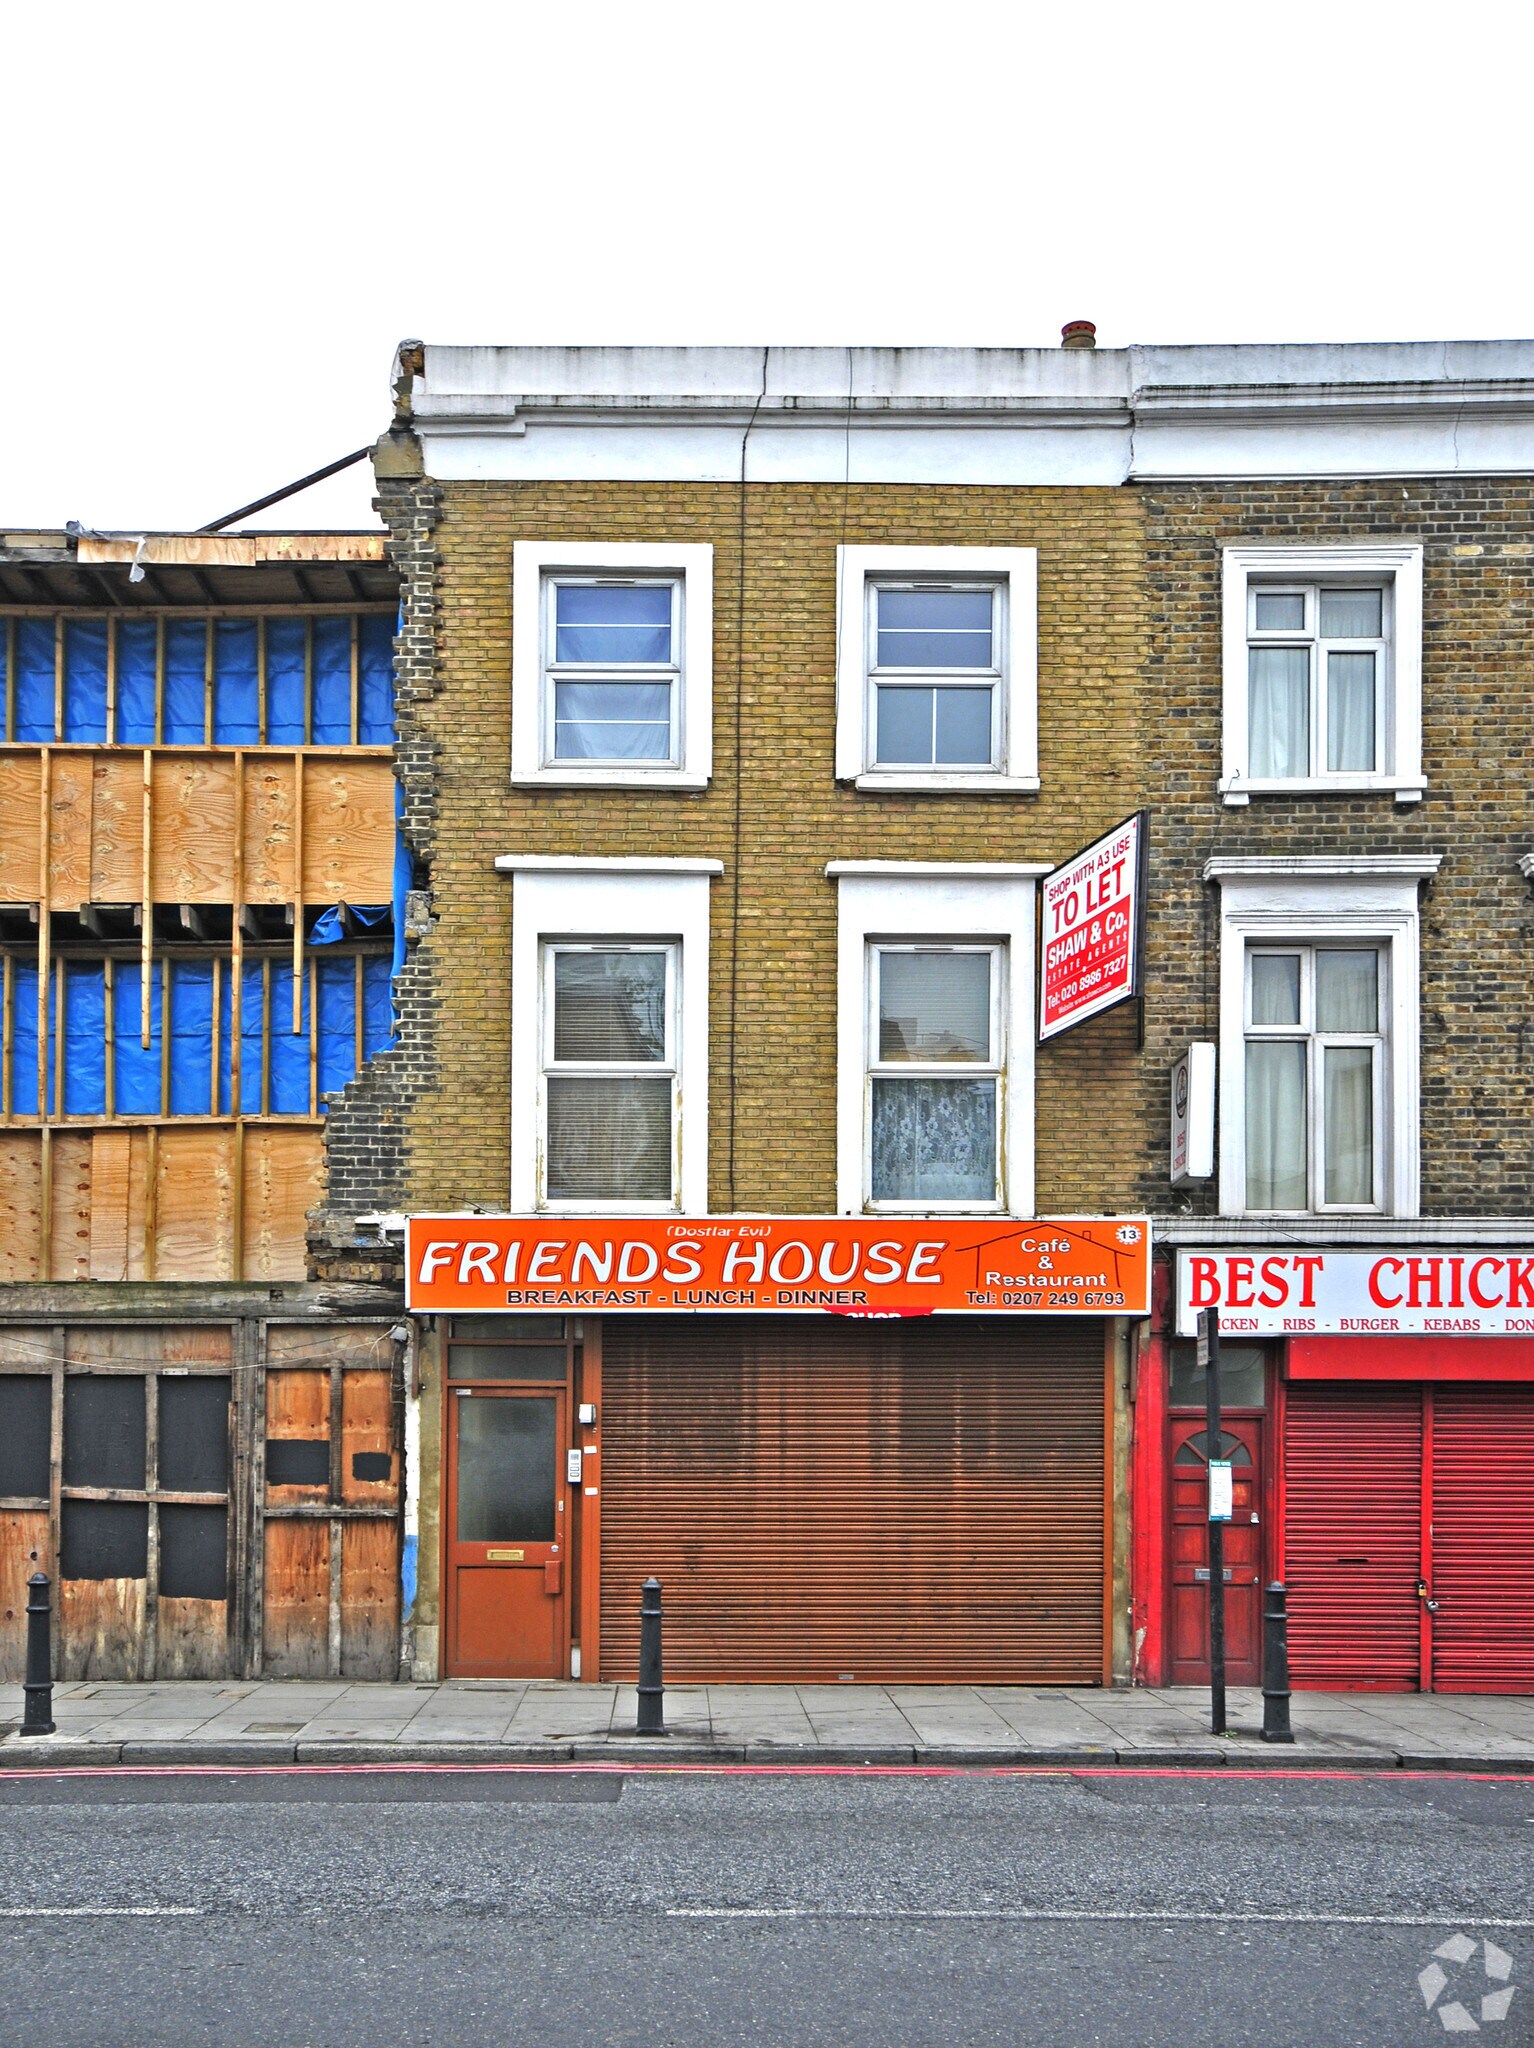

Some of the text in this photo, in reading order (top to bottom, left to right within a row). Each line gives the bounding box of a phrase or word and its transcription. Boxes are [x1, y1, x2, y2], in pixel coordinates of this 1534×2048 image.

[1049, 835, 1130, 901] SHOP WITH A3 USE
[1052, 858, 1125, 933] TO LET
[1048, 911, 1127, 969] SHAW & Co.
[1048, 932, 1127, 985] ESTATE AGENTS
[1047, 954, 1126, 1009] Tel: 020 8986 7327
[667, 1226, 771, 1237] (Dostlar Evi)
[1120, 1230, 1137, 1239] 13
[1021, 1238, 1071, 1252] Café
[417, 1240, 950, 1284] FRIENDS HOUSE
[1038, 1255, 1053, 1269] &
[985, 1271, 1107, 1286] Restaurant
[1188, 1256, 1534, 1309] BEST CHICK
[507, 1290, 652, 1305] BREAKFAST
[673, 1290, 755, 1305] LUNCH
[777, 1290, 867, 1305] DINNER
[966, 1291, 1125, 1306] Tel: 0207 249 6793
[1217, 1318, 1259, 1330] ICKEN
[1283, 1318, 1316, 1330] RIBS
[1340, 1318, 1400, 1330] BURGER
[1424, 1318, 1480, 1330] KEBABS
[1505, 1318, 1534, 1331] DON
